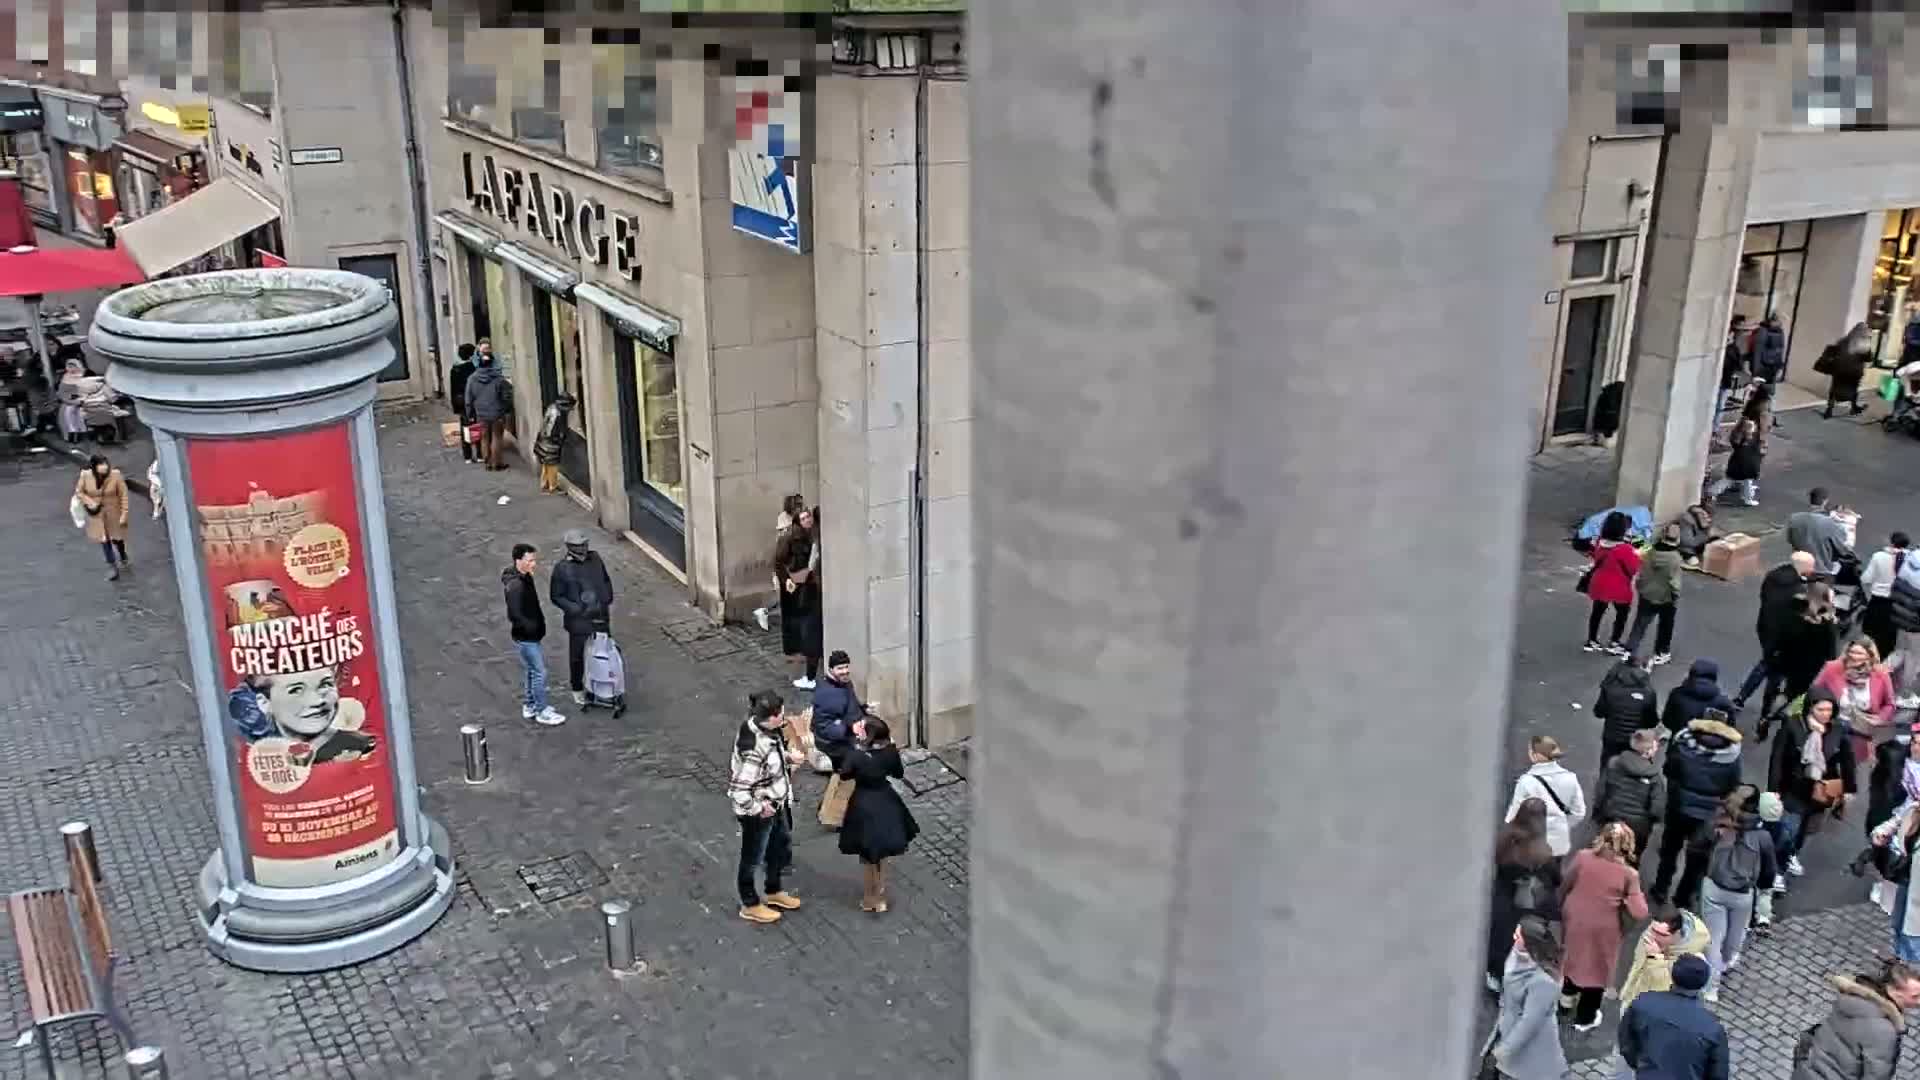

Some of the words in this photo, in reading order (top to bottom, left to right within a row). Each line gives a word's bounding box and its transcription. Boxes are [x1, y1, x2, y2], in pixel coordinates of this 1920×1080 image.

[462, 151, 642, 281] LAFARGE
[230, 606, 334, 648] MARCHÉ
[336, 615, 358, 635] DES
[335, 849, 378, 869] Amiens
